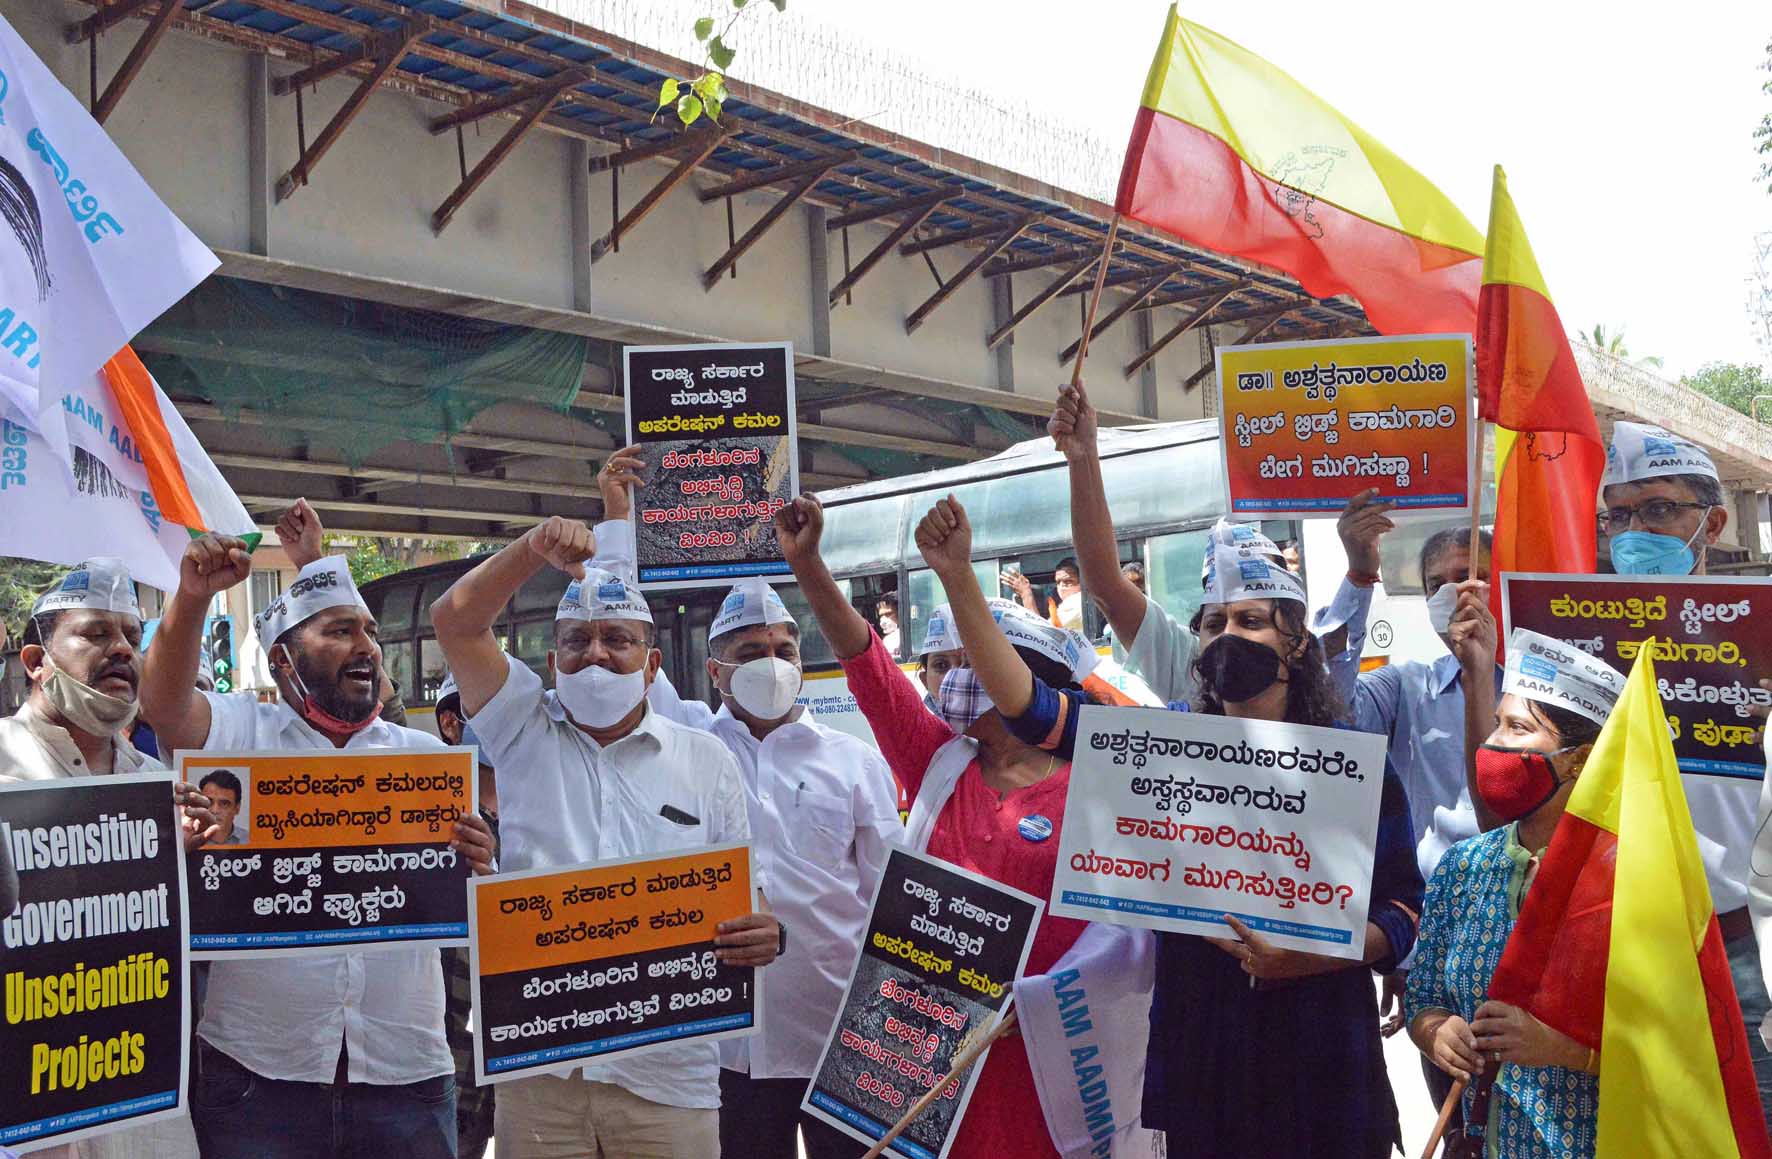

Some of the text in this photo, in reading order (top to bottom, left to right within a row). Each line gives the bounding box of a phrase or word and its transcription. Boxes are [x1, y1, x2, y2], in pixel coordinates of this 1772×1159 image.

[652, 362, 764, 389] ರಾಜ್ಯ ಸರ್ಕಾರ
[1283, 358, 1447, 401] ಅಶ್ವತ್ಥನಾರಾಯಣ
[670, 387, 747, 409] ಮಾಡುತ್ತಿದೆ
[732, 412, 781, 429] ಕಮಲ
[1234, 404, 1456, 447] ಸ್ಟೀಲ್ ಬ್ರಿಡ್ಜ್ ಕಾಮಗಾರಿ
[662, 447, 760, 469] ಬೆಂಗಳೂರಿನ
[1259, 453, 1303, 479] ಬೇಗ
[1423, 452, 1429, 475] !
[1648, 458, 1683, 469] AAM
[681, 475, 744, 500] ಅಭಿವೃದ್ಧಿ
[680, 531, 737, 548] ವಿಲವಿಲ
[1243, 583, 1276, 592] AAM
[1550, 594, 1751, 634] ಕುಂಟುತ್ತಿದೆ ಸ್ಟೀಲ್
[1377, 632, 1388, 642] 30
[1517, 678, 1554, 695] AAM
[375, 771, 464, 798] ಕಮಲದಲ್ಲಿ
[1130, 774, 1307, 816] ಅಸ್ವಸ್ಥವಾಗಿರುವ
[2, 812, 159, 871] Insensitive
[255, 806, 392, 840] ಬ್ಯುಸಿಯಾಗಿದ್ದಾರೆ
[1115, 816, 1312, 871] ಕಾಮಗಾರಿಯನ್ನು
[200, 846, 457, 890] ಸ್ಟೀಲ್ ಬ್ರಿಡ್ಜ್ ಕಾಮಗಾರಿಗೆ
[1070, 850, 1354, 910] ಯಾವಾಗ ಮುಗಿಸುತ್ತೀರಿ?
[253, 888, 312, 916] ಆಗಿದೆ
[500, 862, 732, 921] ರಾಜ್ಯ ಸರ್ಕಾರ ಮಾಡುತ್ತಿದೆ
[903, 878, 1011, 932] ರಾಜ್ಯ ಸರ್ಕಾರ
[3, 883, 170, 949] Government
[649, 908, 704, 930] ಕಮಲ
[911, 914, 985, 957] ಮಾಡುತ್ತಿದೆ
[5, 952, 170, 1025] Unscientific
[522, 950, 718, 999] ಬೆಂಗಳೂರಿನ ಅಭಿವೃದ್ಧಿ
[958, 967, 1004, 998] ಕಮಲ
[490, 994, 660, 1042] ಕಾರ್ಯಗಳಾಗುತ್ತಿವೆ
[668, 984, 733, 1012] ವಿಲವಿಲ
[743, 981, 748, 999] !
[880, 978, 969, 1030] ಬೆಂಗಳೂರಿನ
[1053, 967, 1094, 1038] AAM
[885, 1016, 940, 1063] ಅಭಿವೃದ್ಧಿ
[31, 1031, 145, 1095] Projects
[856, 1072, 904, 1107] ವಿಲವಿಲ
[1070, 1045, 1117, 1142] AADMI
